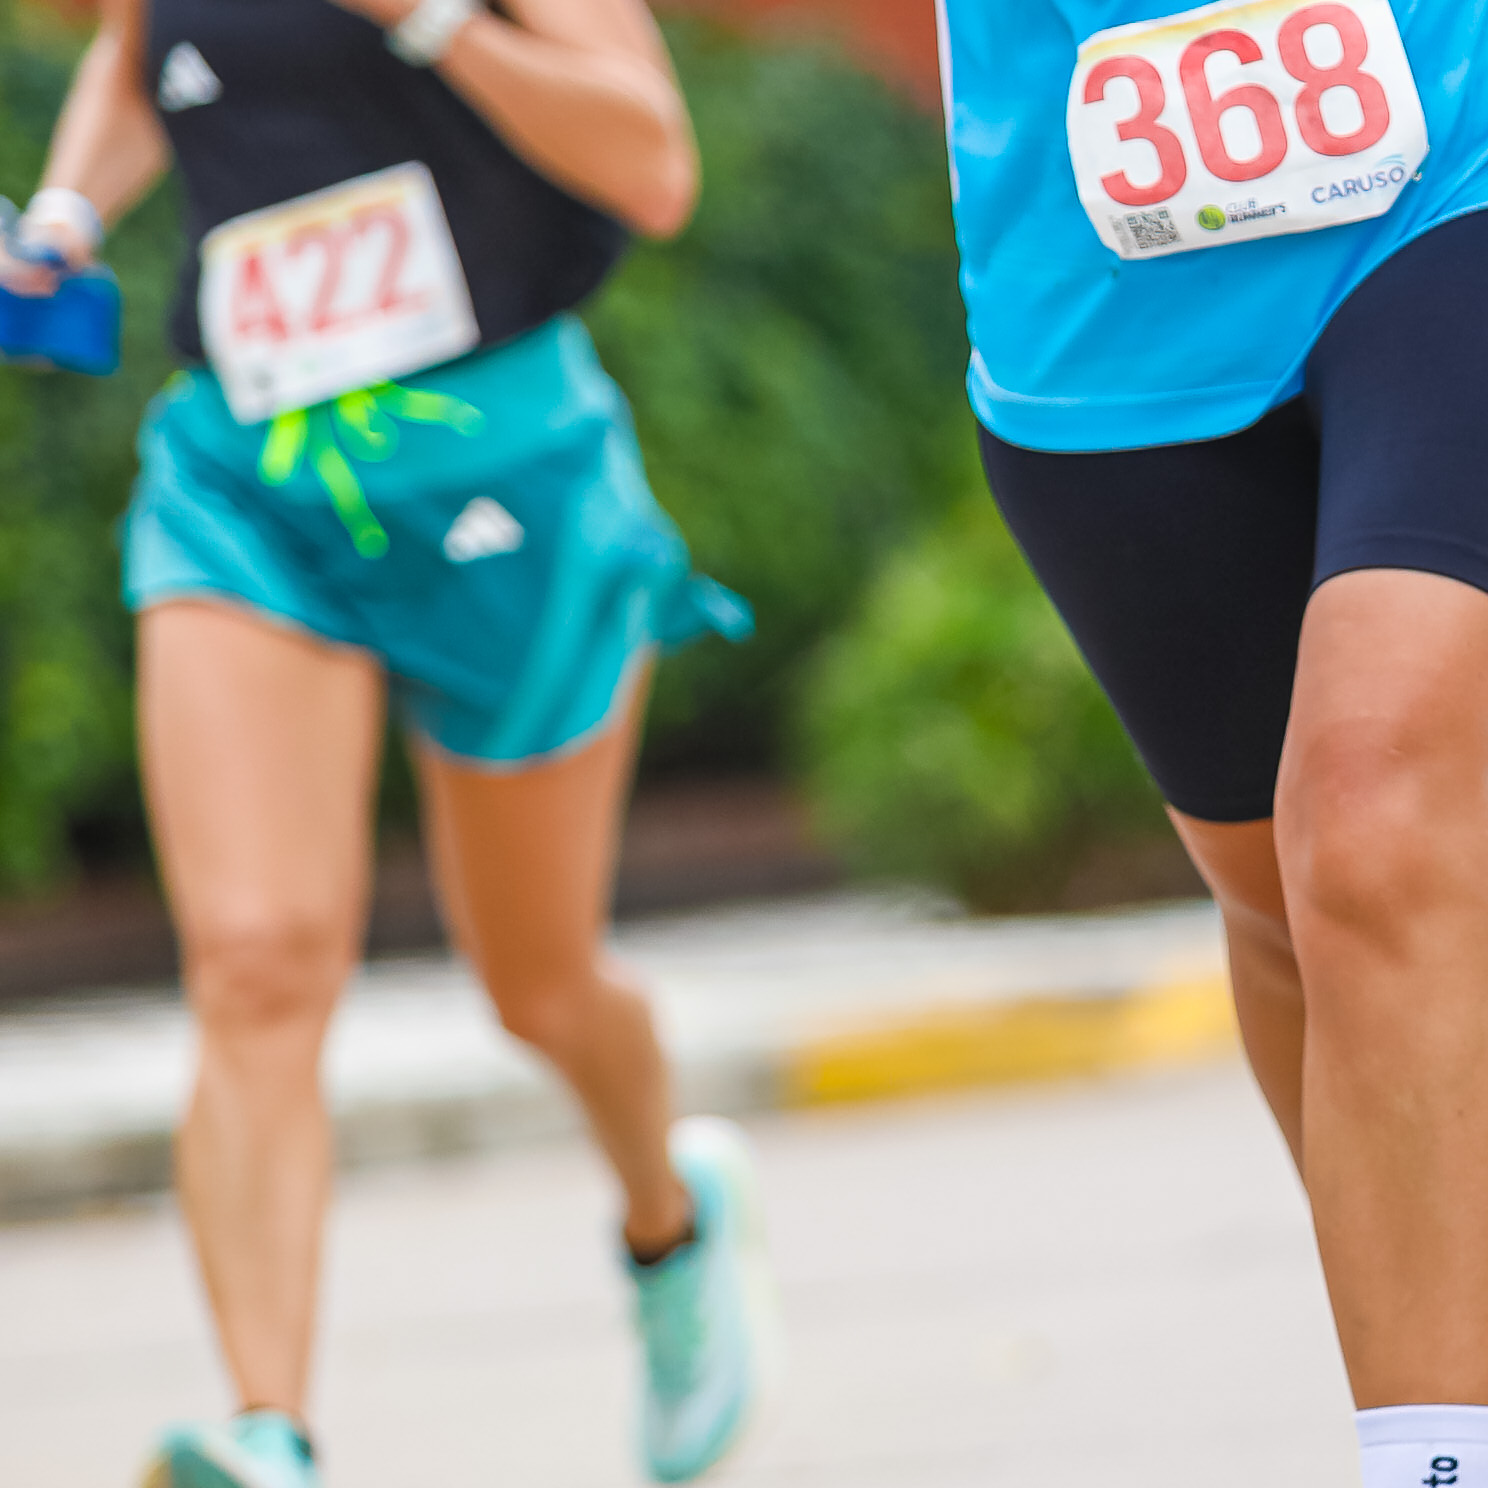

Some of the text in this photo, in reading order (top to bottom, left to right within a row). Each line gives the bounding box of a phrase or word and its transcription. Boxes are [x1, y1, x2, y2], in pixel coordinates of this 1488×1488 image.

[1082, 0, 1391, 207] 368
[1310, 165, 1405, 204] CARUSO
[229, 196, 430, 342] 422
